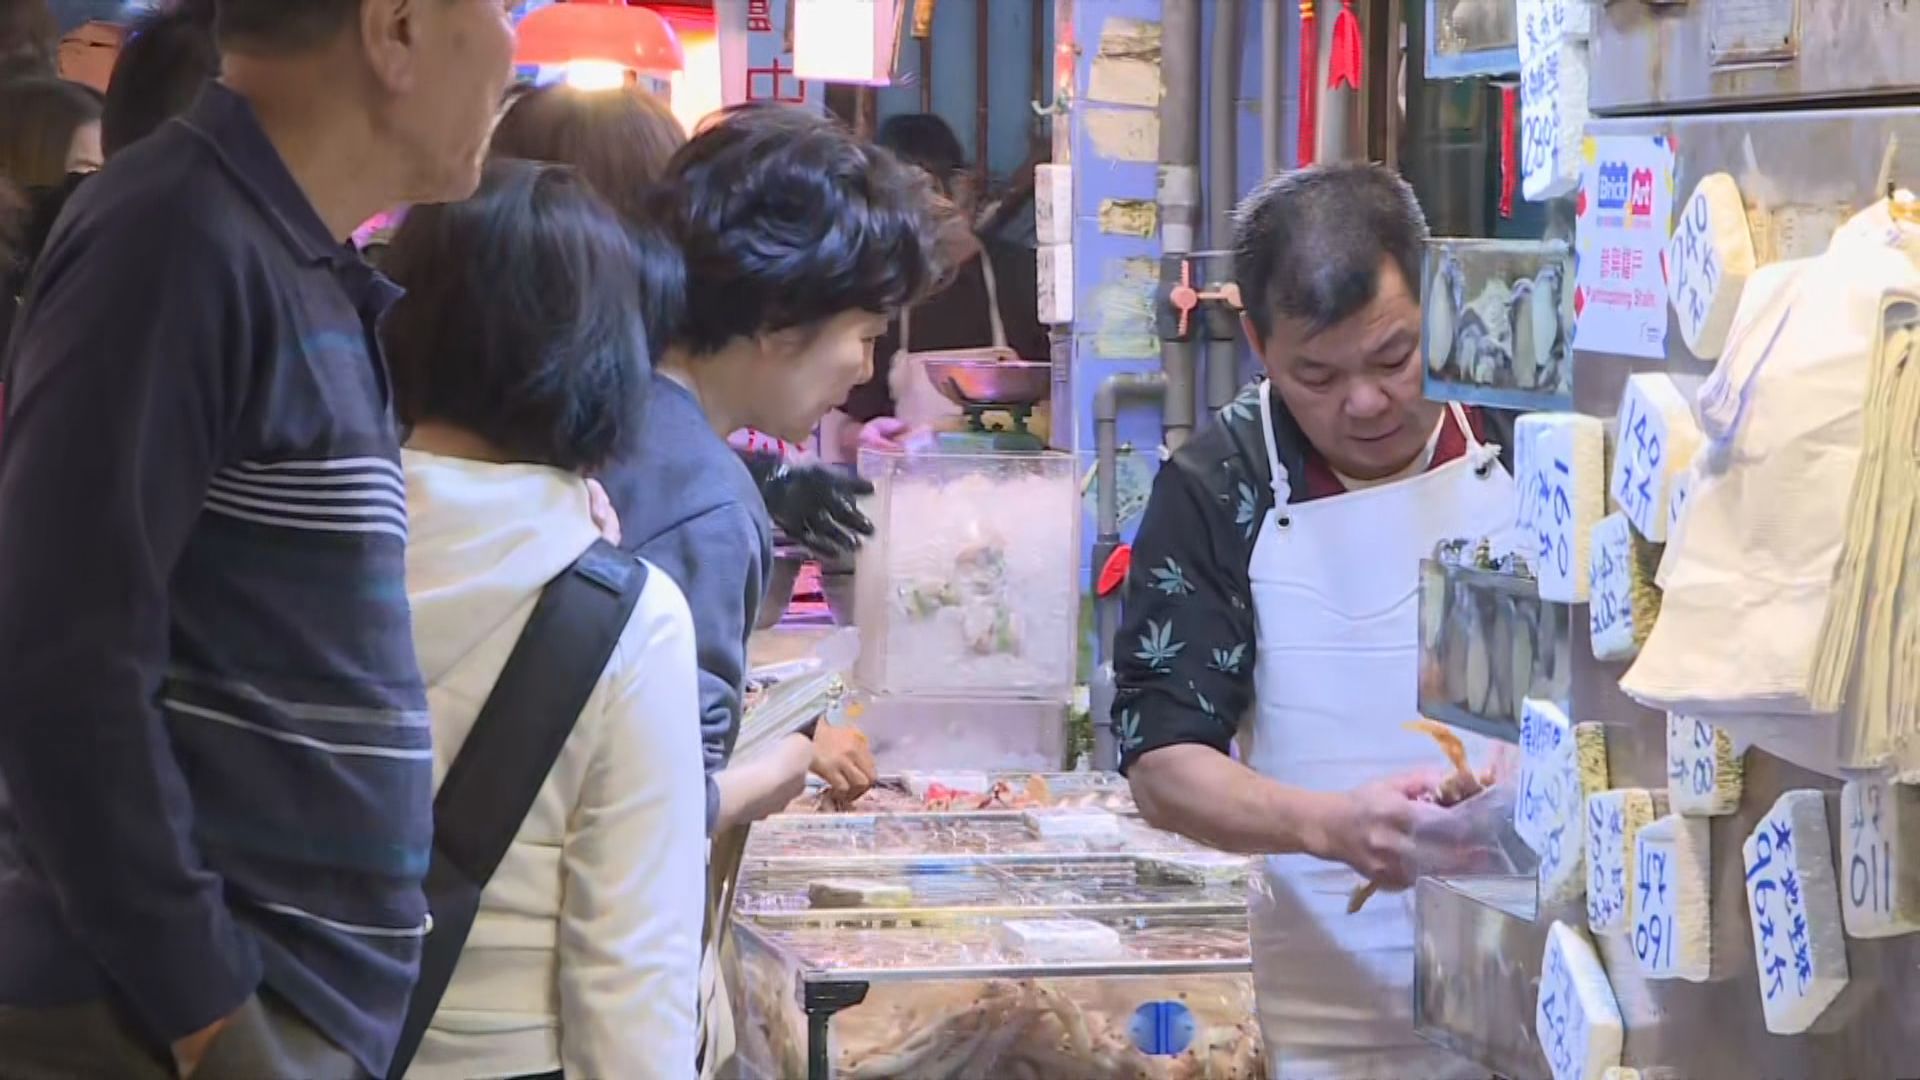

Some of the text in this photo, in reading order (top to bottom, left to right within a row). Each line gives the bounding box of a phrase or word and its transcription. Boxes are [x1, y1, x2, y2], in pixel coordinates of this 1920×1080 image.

[1599, 175, 1651, 206] Brick Art
[1624, 398, 1662, 468] 140
[1553, 458, 1573, 579] 160
[1850, 841, 1890, 914] 110
